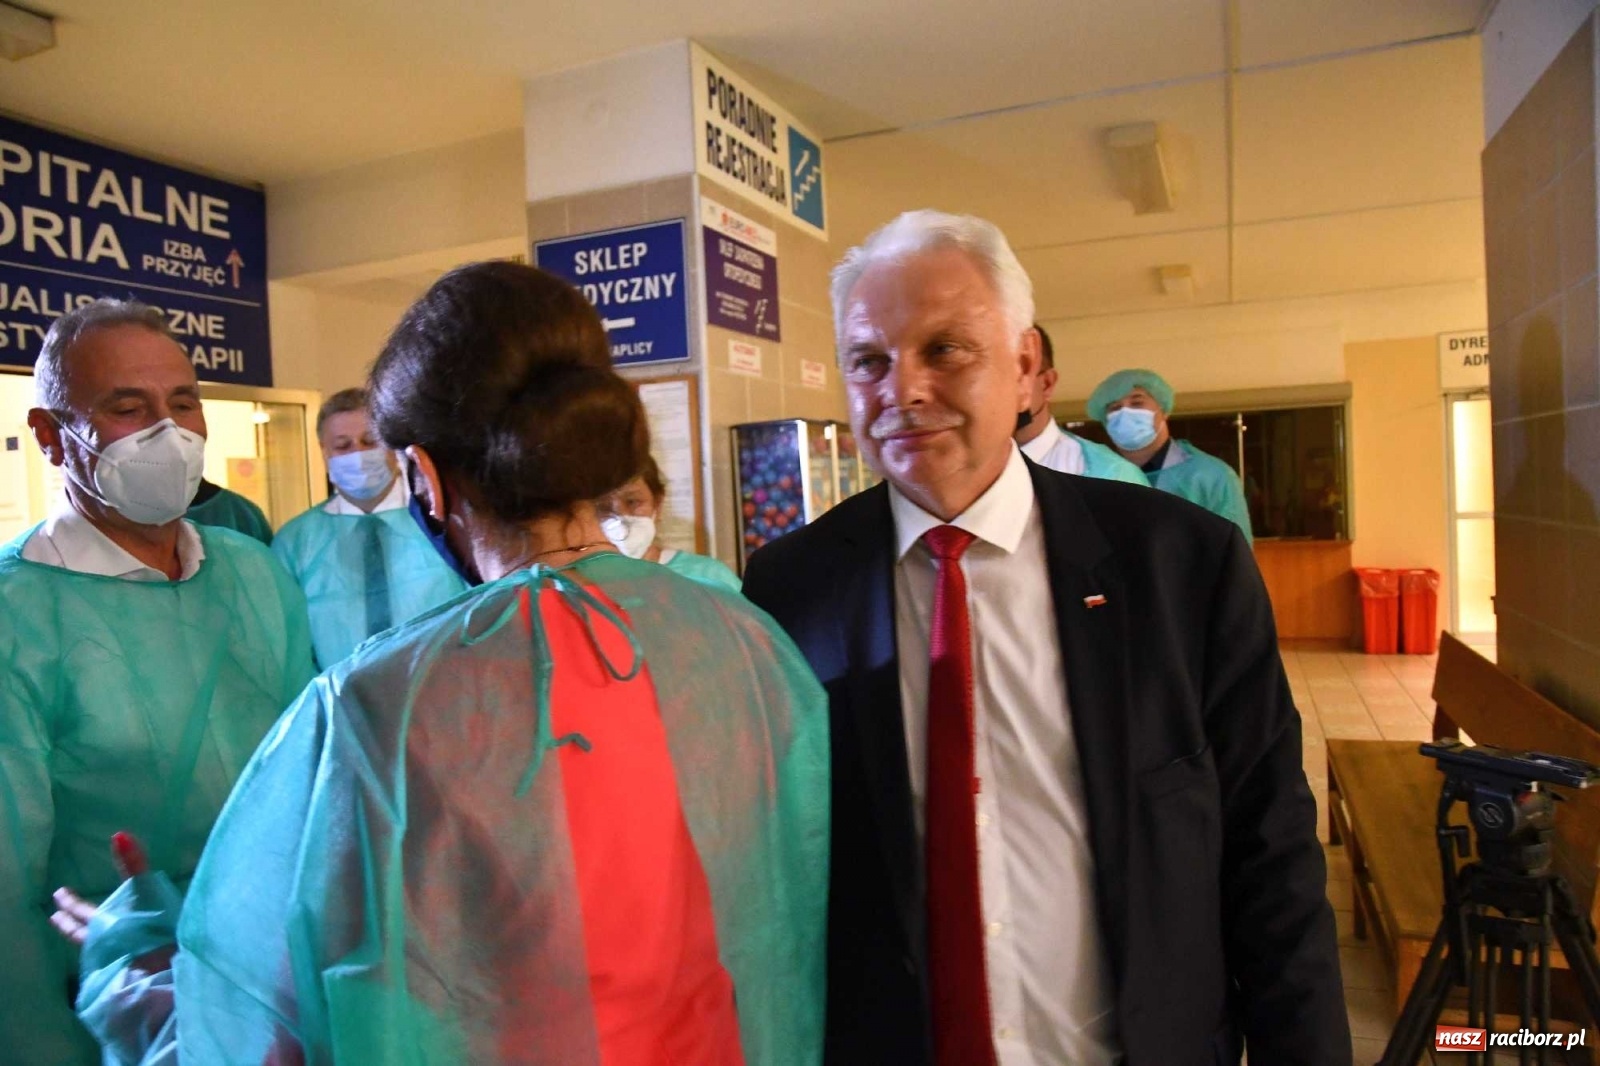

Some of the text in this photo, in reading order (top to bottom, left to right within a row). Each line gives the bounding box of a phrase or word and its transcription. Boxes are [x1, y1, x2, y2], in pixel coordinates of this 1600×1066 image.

[706, 67, 777, 154] PORADNIE
[705, 120, 787, 206] REJESTRACJA
[0, 139, 231, 240] PITALNE
[164, 239, 207, 263] IZBA
[574, 242, 648, 275] SKLEP
[142, 253, 227, 288] PRZYJĘĆ
[575, 272, 677, 306] DYCZNY
[180, 343, 244, 372] APII
